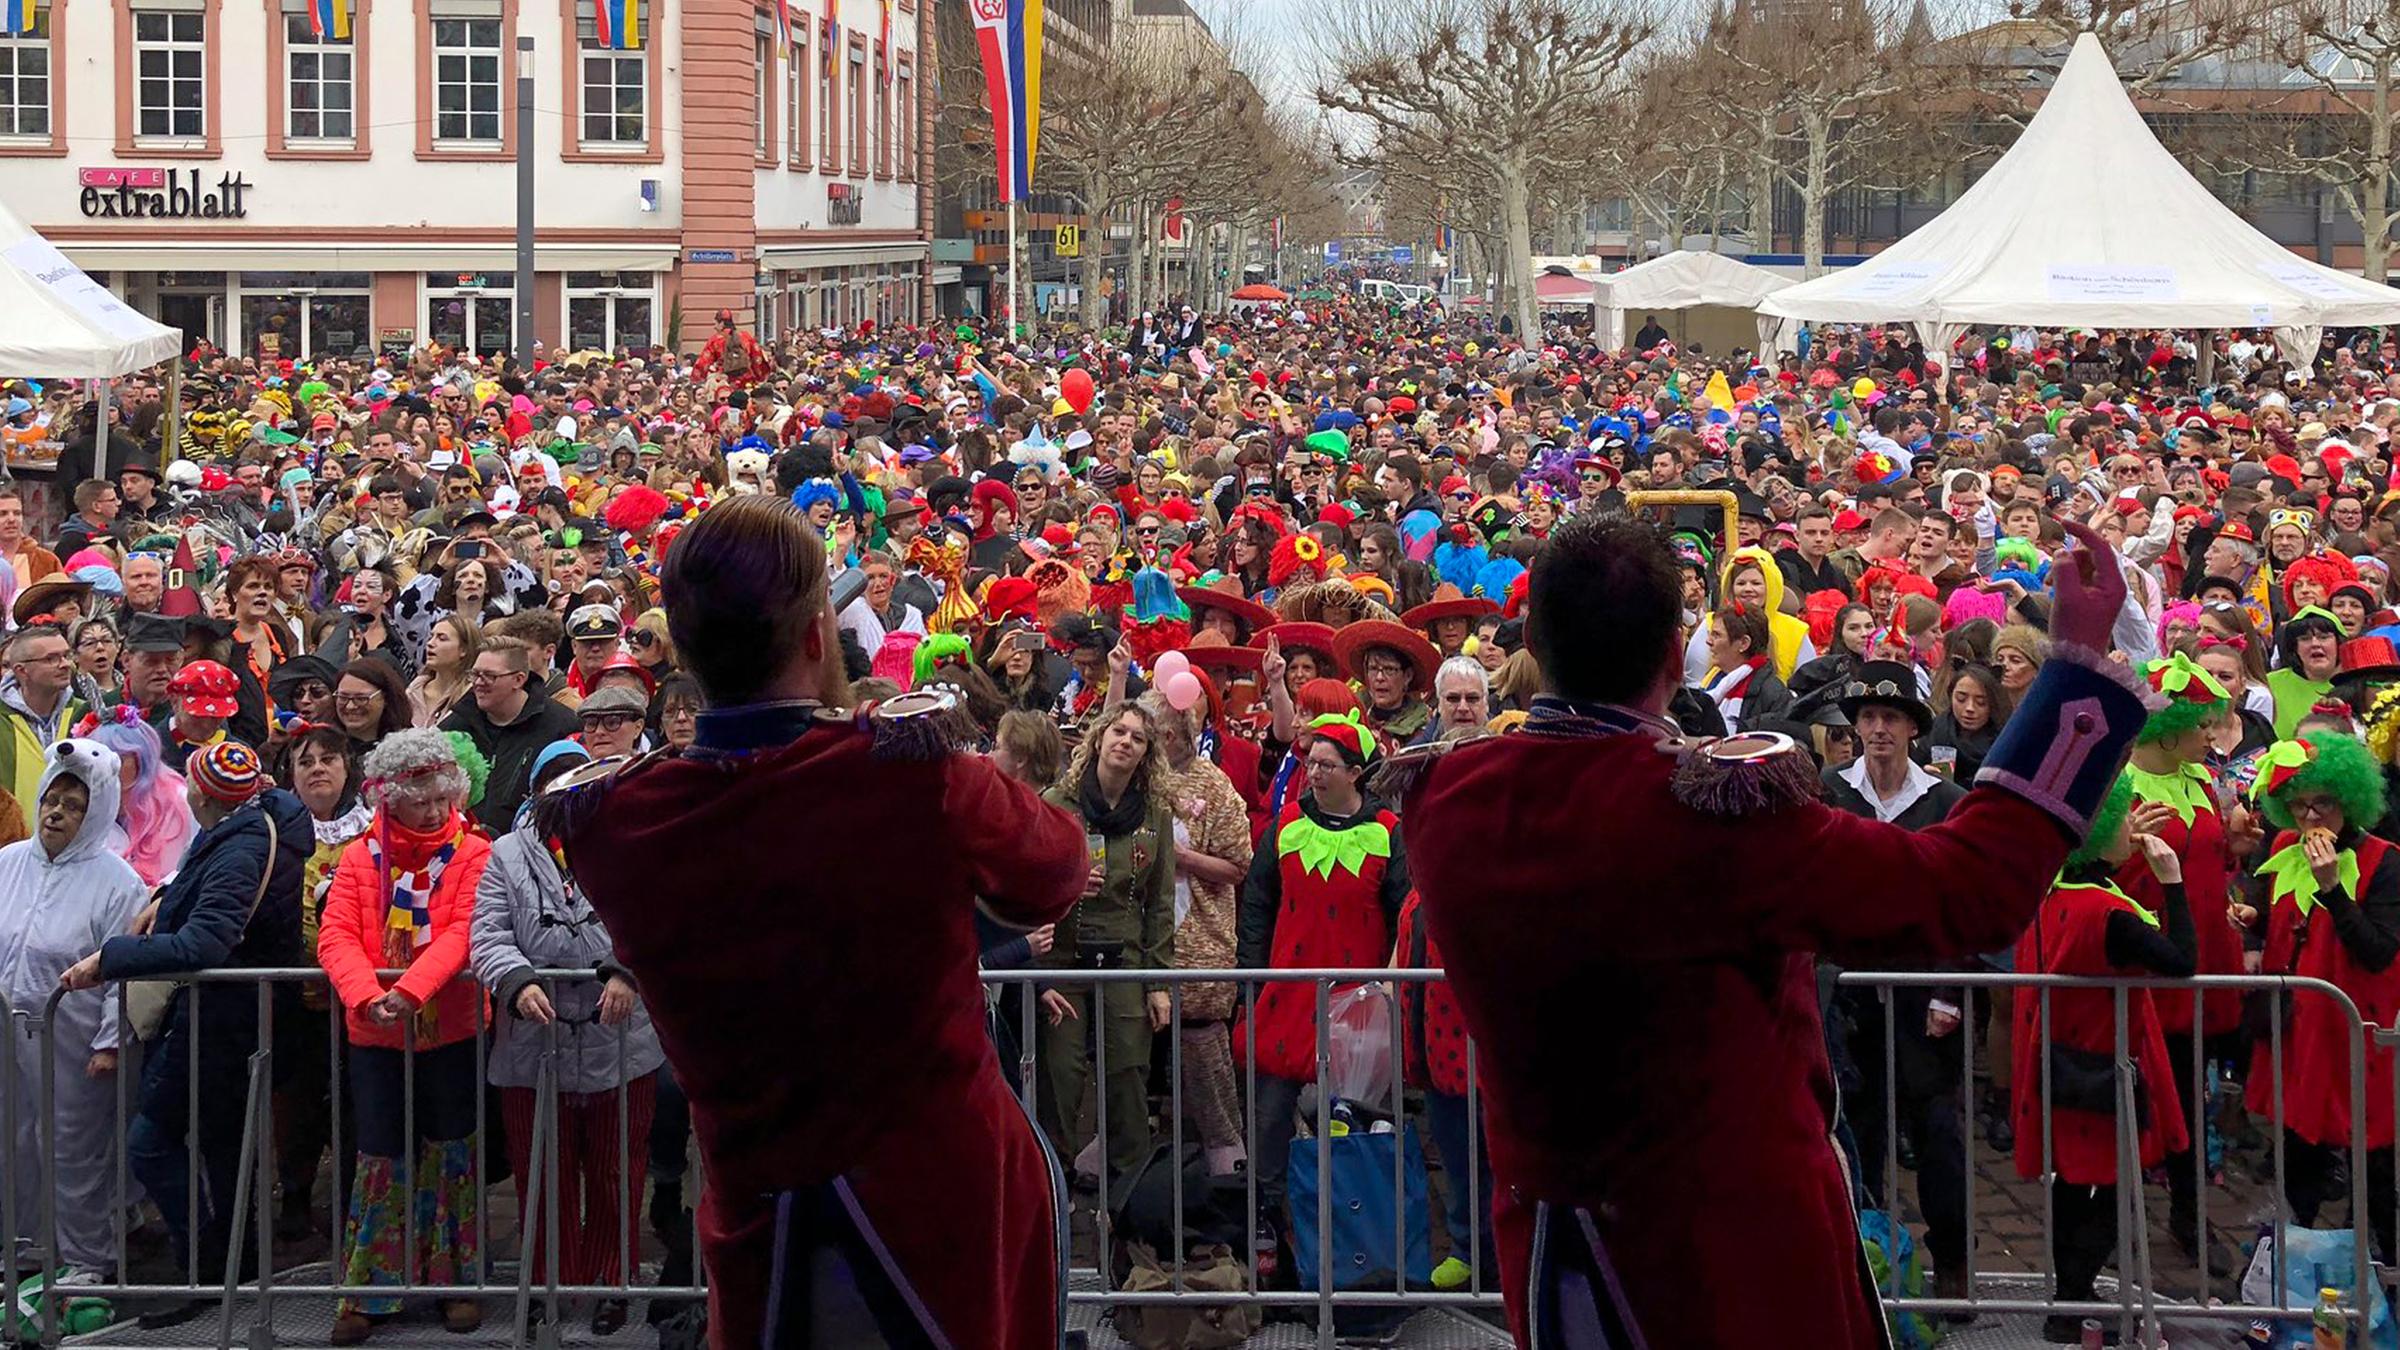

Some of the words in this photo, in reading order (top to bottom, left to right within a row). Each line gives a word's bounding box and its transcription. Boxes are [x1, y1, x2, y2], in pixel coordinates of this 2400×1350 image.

[83, 171, 160, 182] CAFE
[80, 168, 253, 218] extrablatt
[1060, 225, 1075, 245] 61
